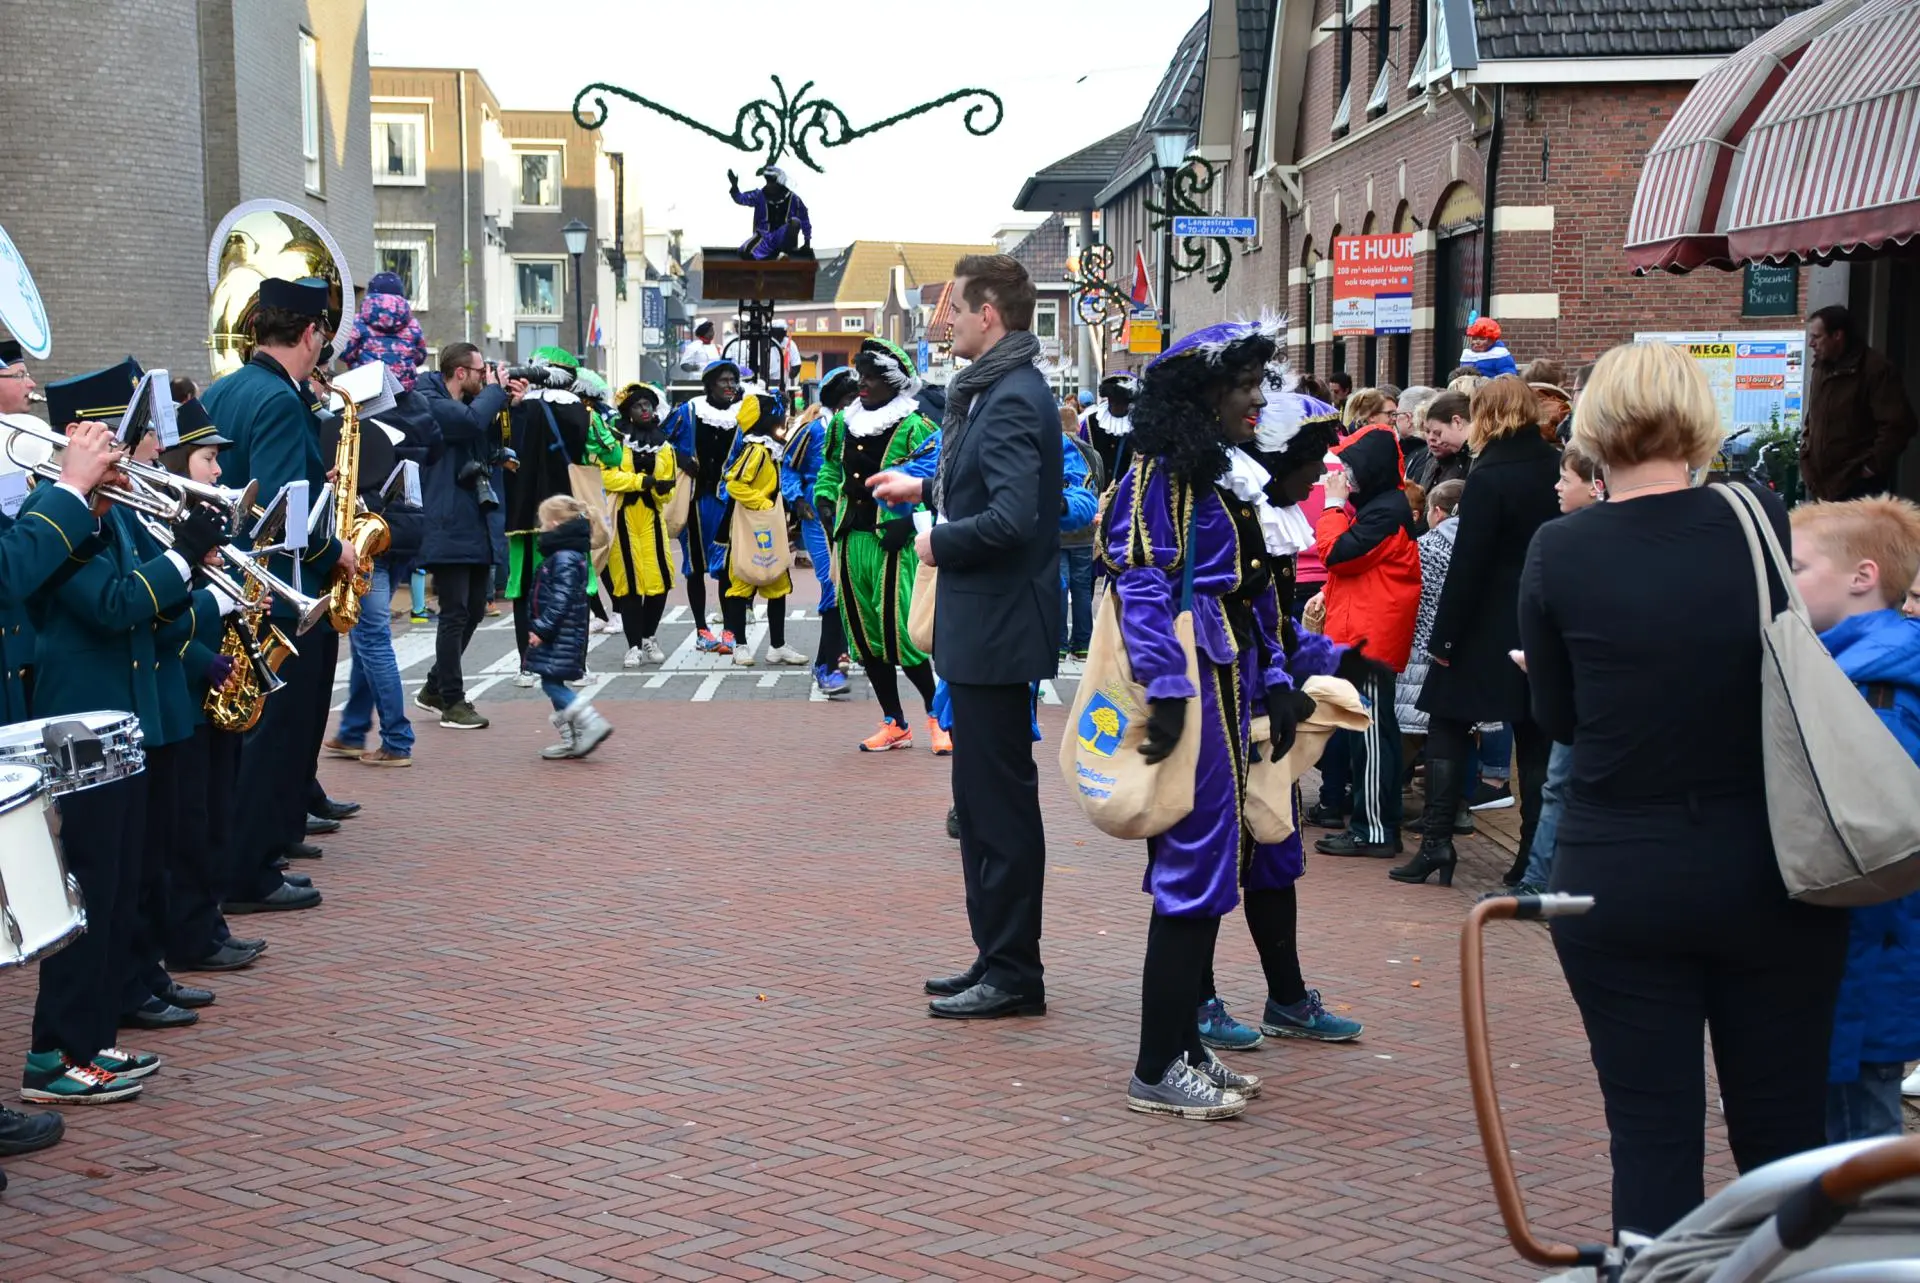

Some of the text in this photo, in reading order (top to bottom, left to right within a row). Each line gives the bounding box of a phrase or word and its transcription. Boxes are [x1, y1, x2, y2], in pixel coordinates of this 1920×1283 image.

[1337, 237, 1414, 260] TE HUUR
[1362, 264, 1385, 273] winkel
[1345, 276, 1398, 288] ook toegang via
[1690, 345, 1731, 354] MEGA
